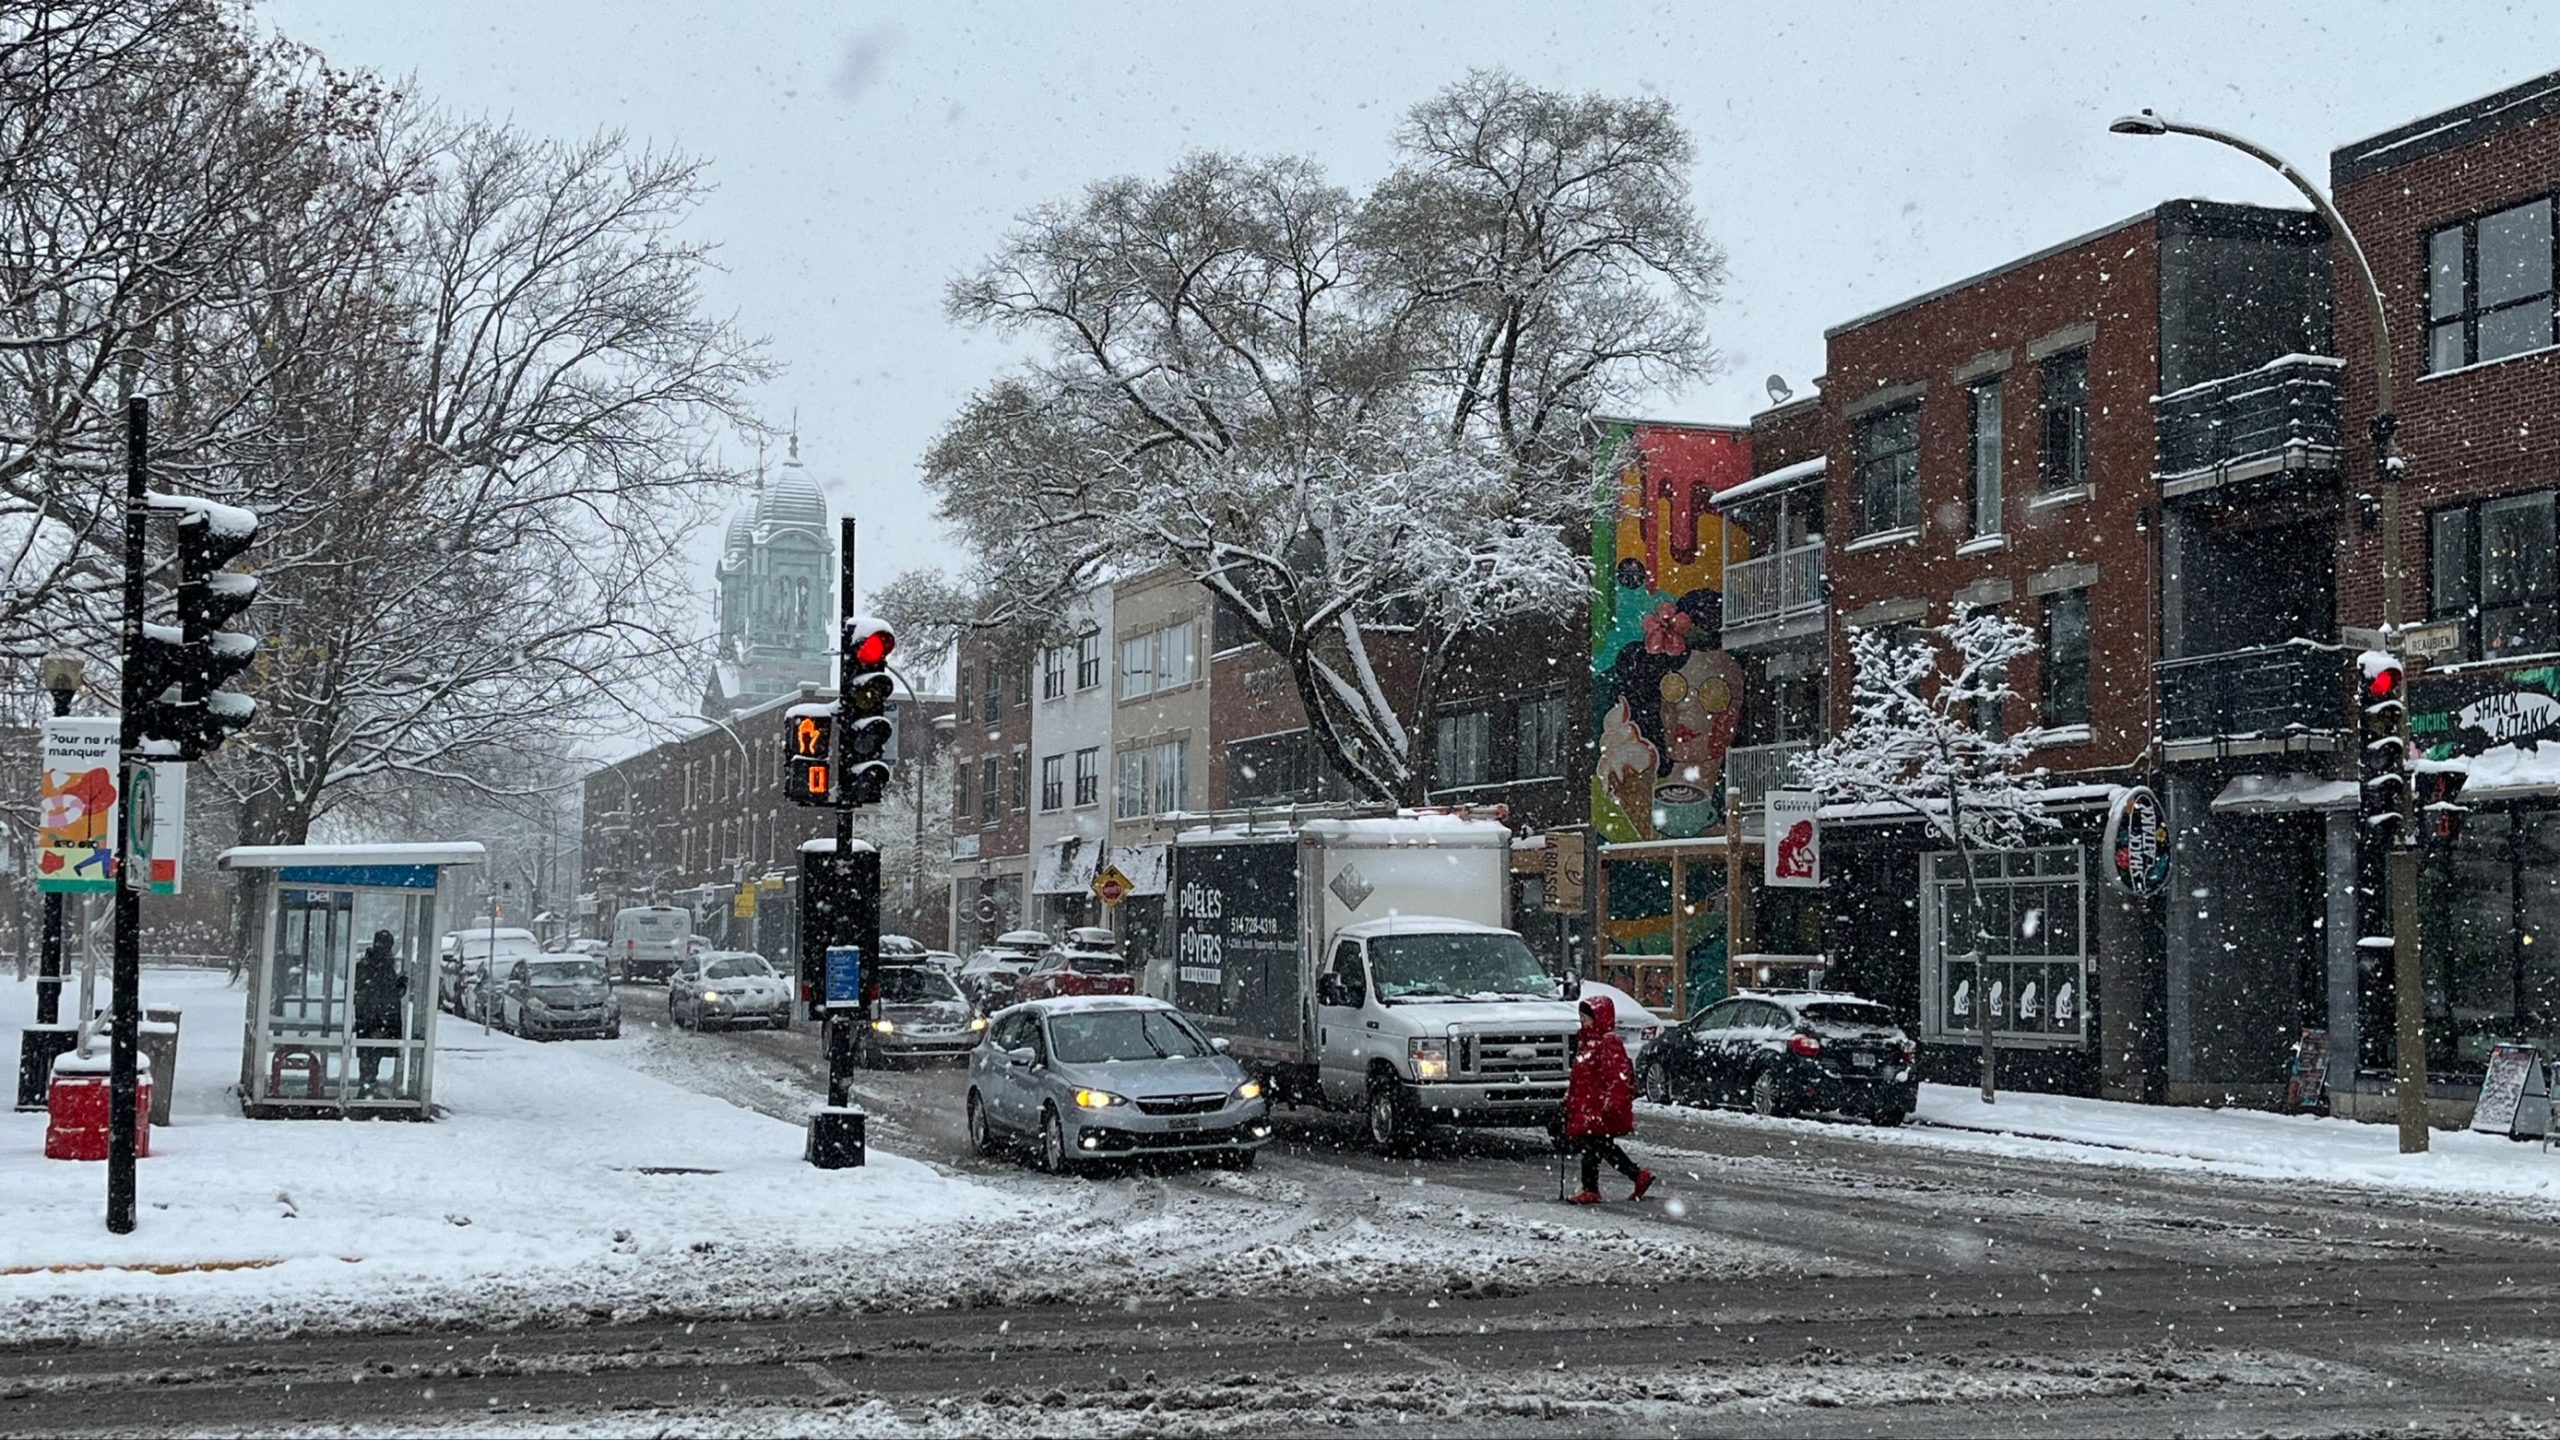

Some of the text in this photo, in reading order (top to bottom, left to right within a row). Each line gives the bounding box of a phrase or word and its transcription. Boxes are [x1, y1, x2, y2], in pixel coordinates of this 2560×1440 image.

[2411, 635, 2452, 653] BEAUBIEN
[2474, 691, 2518, 722] SHACK
[2495, 704, 2550, 739] ATTAKK
[2411, 711, 2449, 735] UNCHS
[49, 748, 107, 759] manquer
[50, 733, 121, 746] Pour ne rie
[808, 766, 826, 793] 0
[2140, 803, 2156, 859] ATTAKK
[2129, 834, 2144, 878] SHACK
[1180, 882, 1222, 918] POÊLES
[1180, 926, 1222, 964] FOYERS
